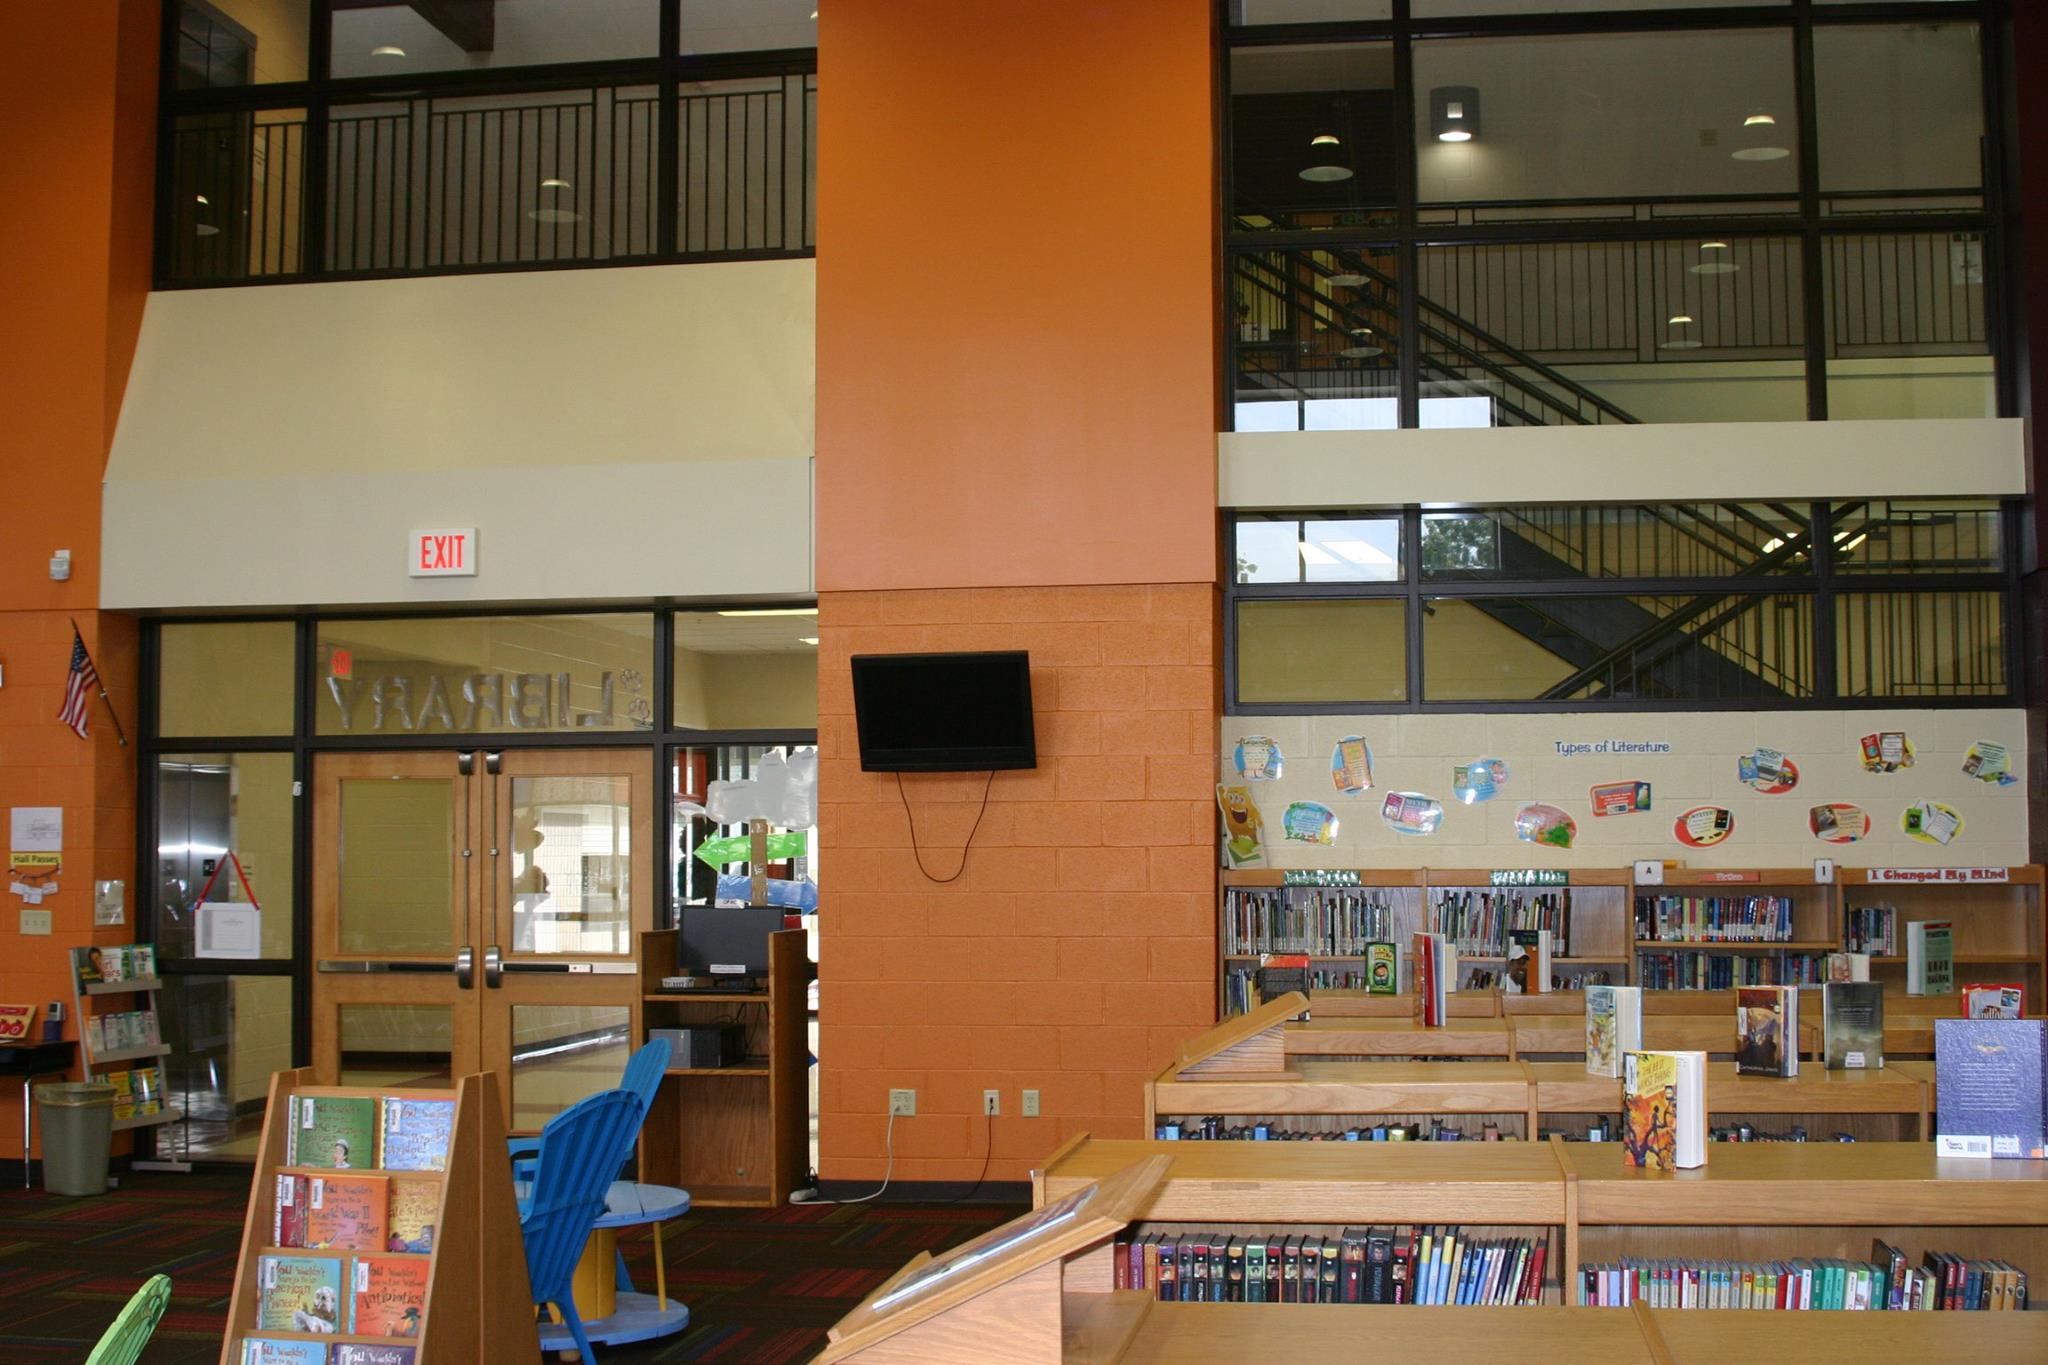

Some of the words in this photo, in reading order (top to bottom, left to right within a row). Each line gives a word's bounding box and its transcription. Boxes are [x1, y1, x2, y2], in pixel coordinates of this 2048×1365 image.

[420, 535, 465, 569] EXIT
[1555, 741, 1591, 756] Types
[1595, 740, 1609, 752] of
[1611, 740, 1670, 753] Literature
[14, 855, 30, 864] Hall
[32, 855, 59, 864] Passes
[1646, 866, 1652, 875] A
[1871, 869, 1878, 880] I
[1883, 869, 1941, 882] Changed
[1944, 869, 1967, 882] My
[1971, 867, 2006, 880] Mind
